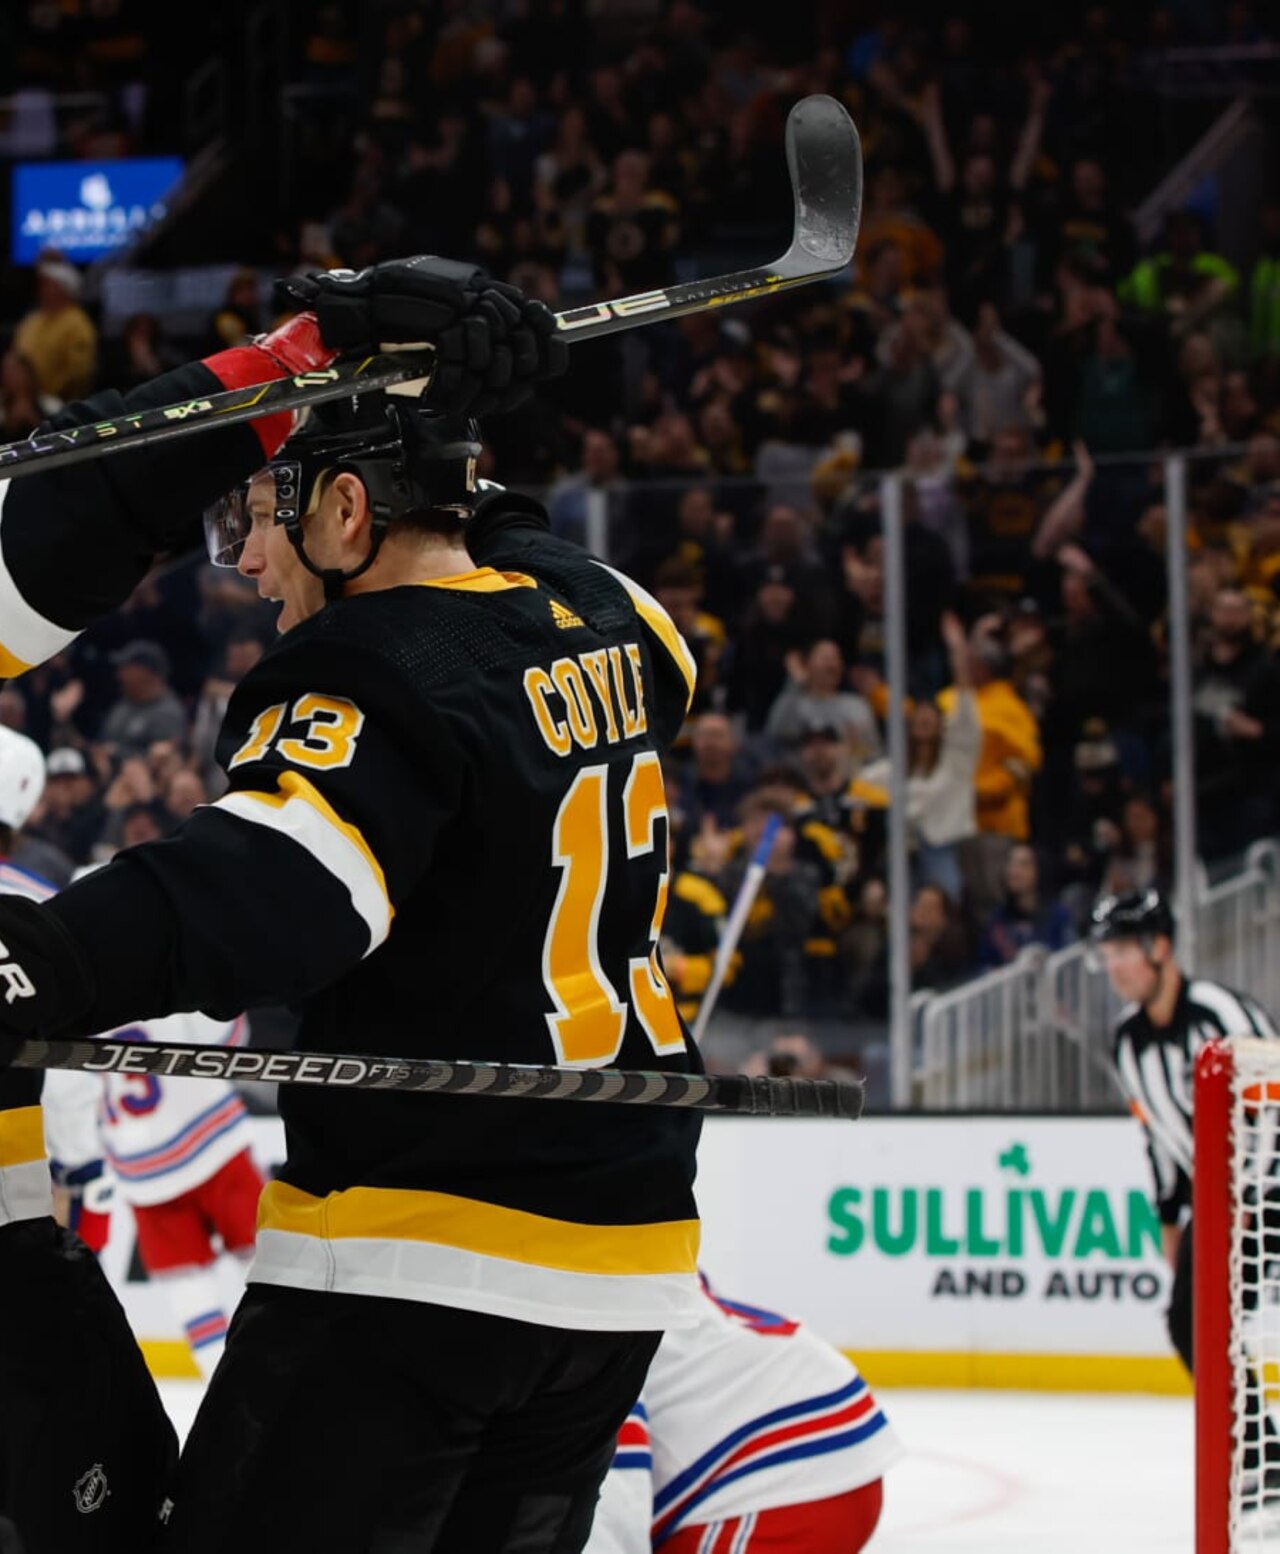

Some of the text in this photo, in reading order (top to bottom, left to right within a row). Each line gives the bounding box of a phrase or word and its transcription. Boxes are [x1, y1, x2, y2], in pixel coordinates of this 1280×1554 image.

[227, 691, 366, 772] 13
[522, 643, 648, 758] COYLE
[542, 750, 688, 1069] 13
[82, 1044, 367, 1085] JETSPEED
[933, 1269, 1160, 1300] AND AUTO
